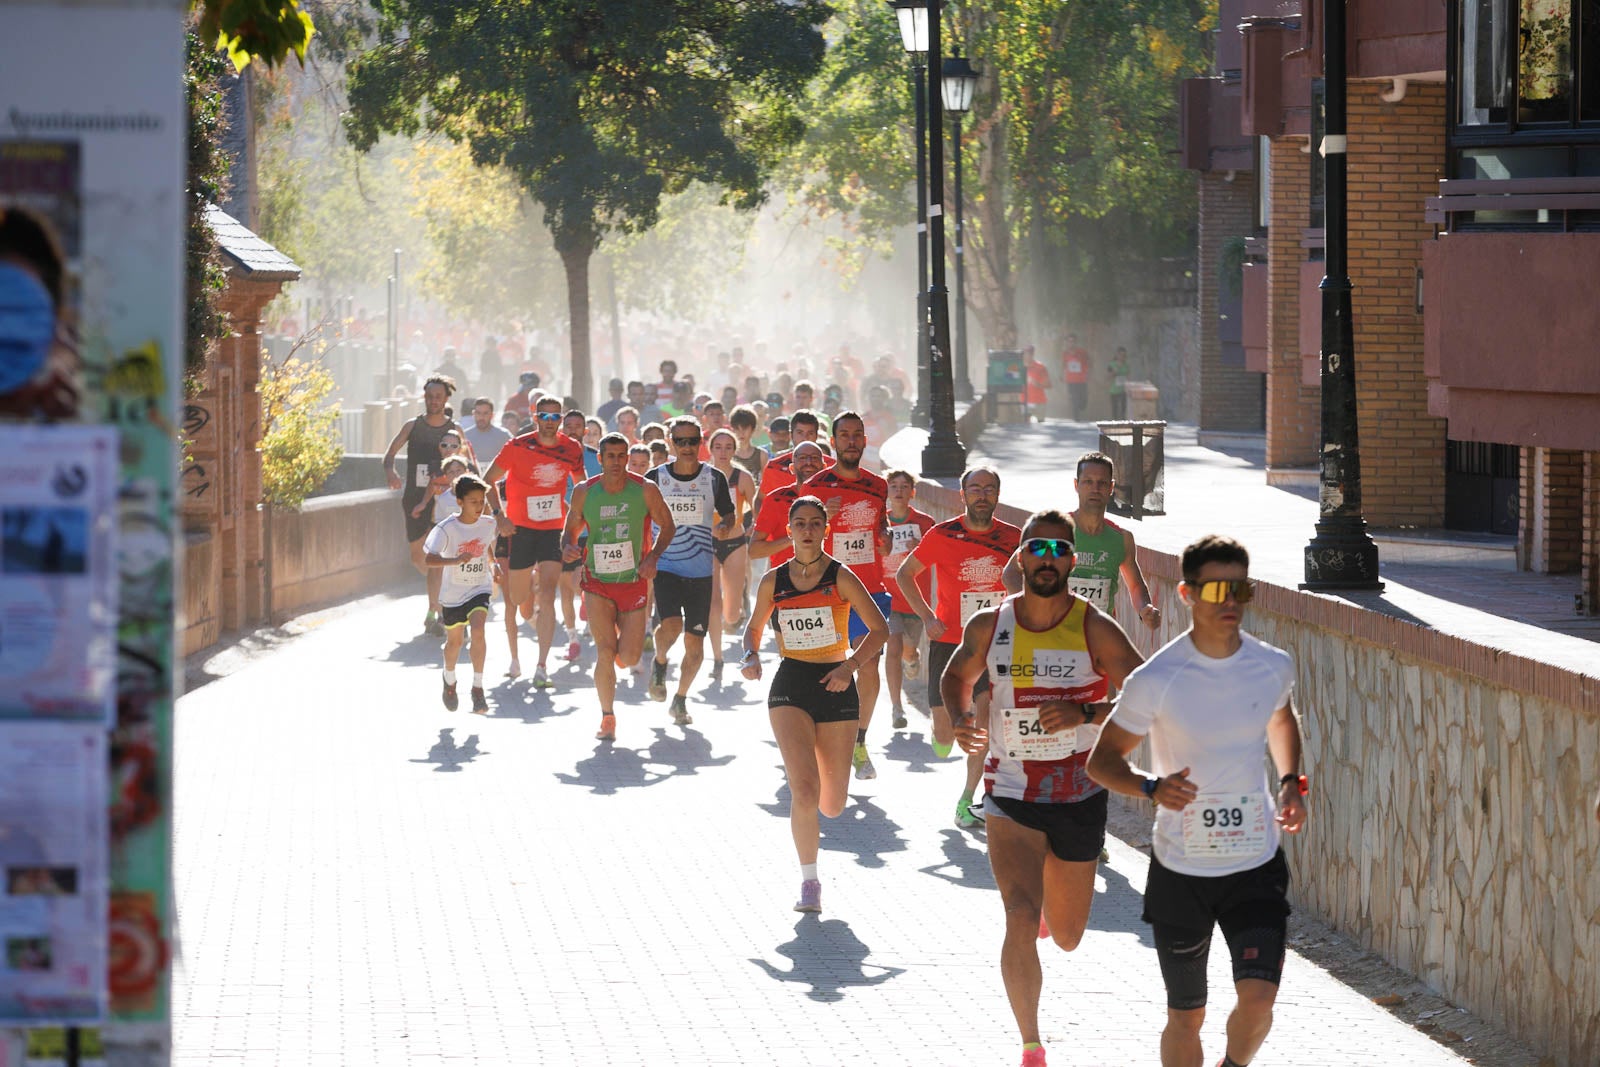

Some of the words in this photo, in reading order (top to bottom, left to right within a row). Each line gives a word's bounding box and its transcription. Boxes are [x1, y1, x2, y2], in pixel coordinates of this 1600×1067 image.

[536, 501, 552, 509] 127
[670, 503, 696, 512] 1655
[843, 539, 865, 550] 148
[602, 549, 623, 559] 748
[460, 563, 484, 573] 1580
[1072, 586, 1103, 599] 1271
[787, 617, 824, 631] 1064
[1018, 720, 1048, 736] 54
[1203, 807, 1243, 828] 939
